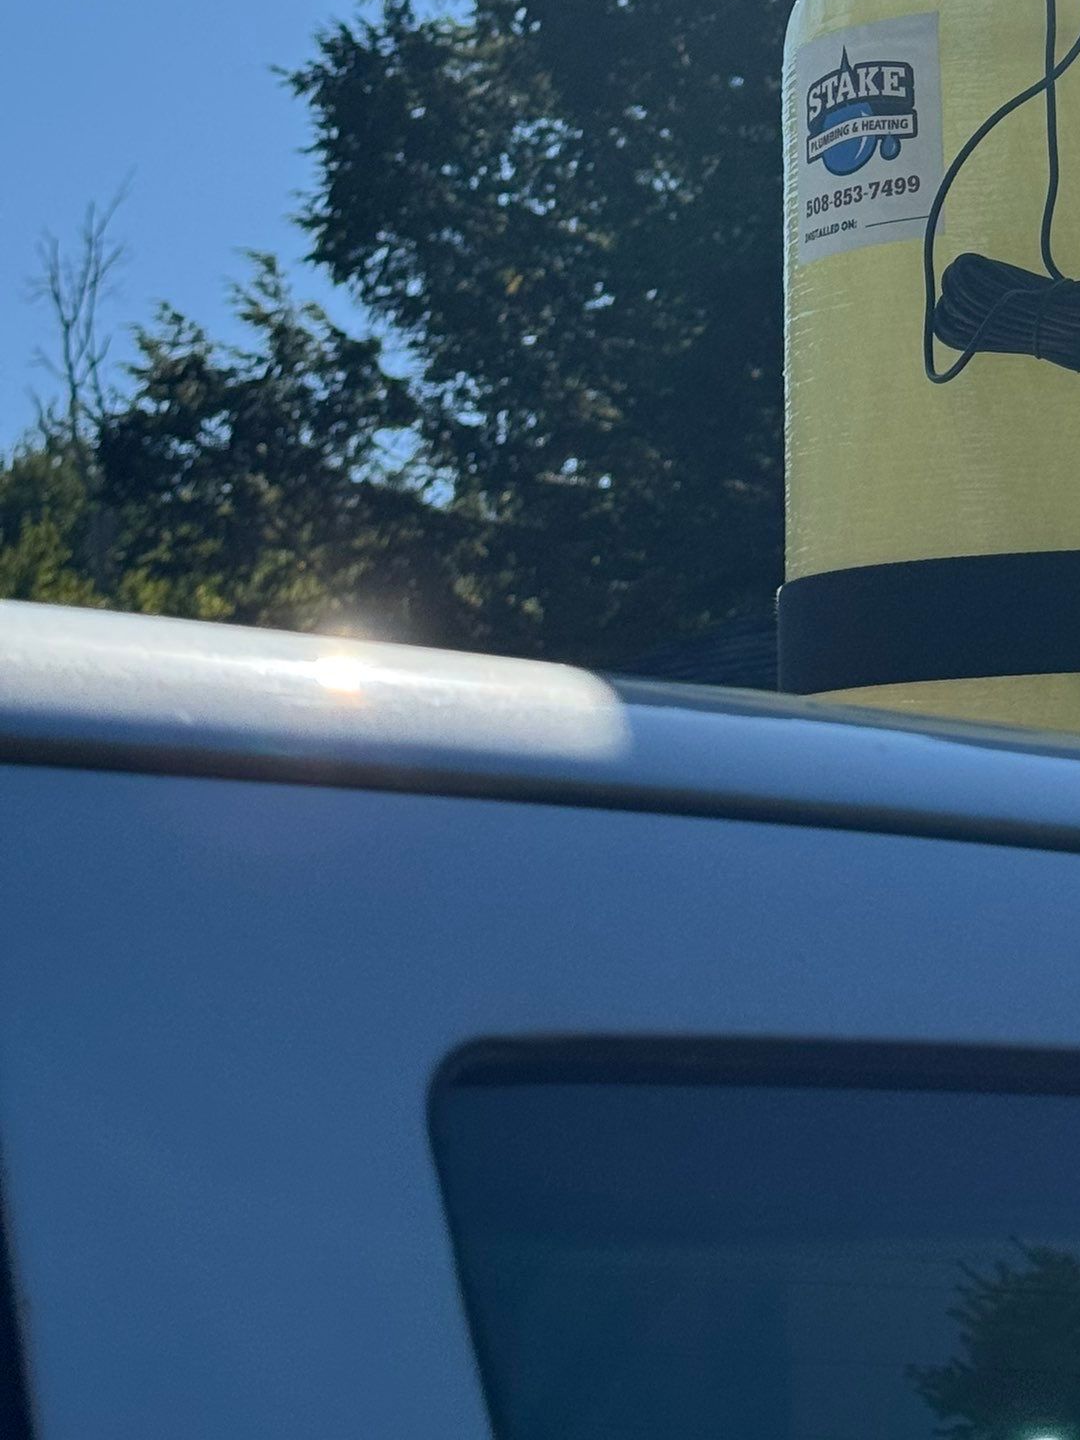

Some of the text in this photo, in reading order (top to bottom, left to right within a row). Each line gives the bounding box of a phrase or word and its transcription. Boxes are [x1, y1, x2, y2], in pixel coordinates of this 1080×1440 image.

[809, 66, 906, 120] STAKE
[810, 118, 909, 153] PLUMBING & HEATING
[806, 175, 921, 219] 508-853-7499
[804, 219, 858, 244] INSTALLED ON:
